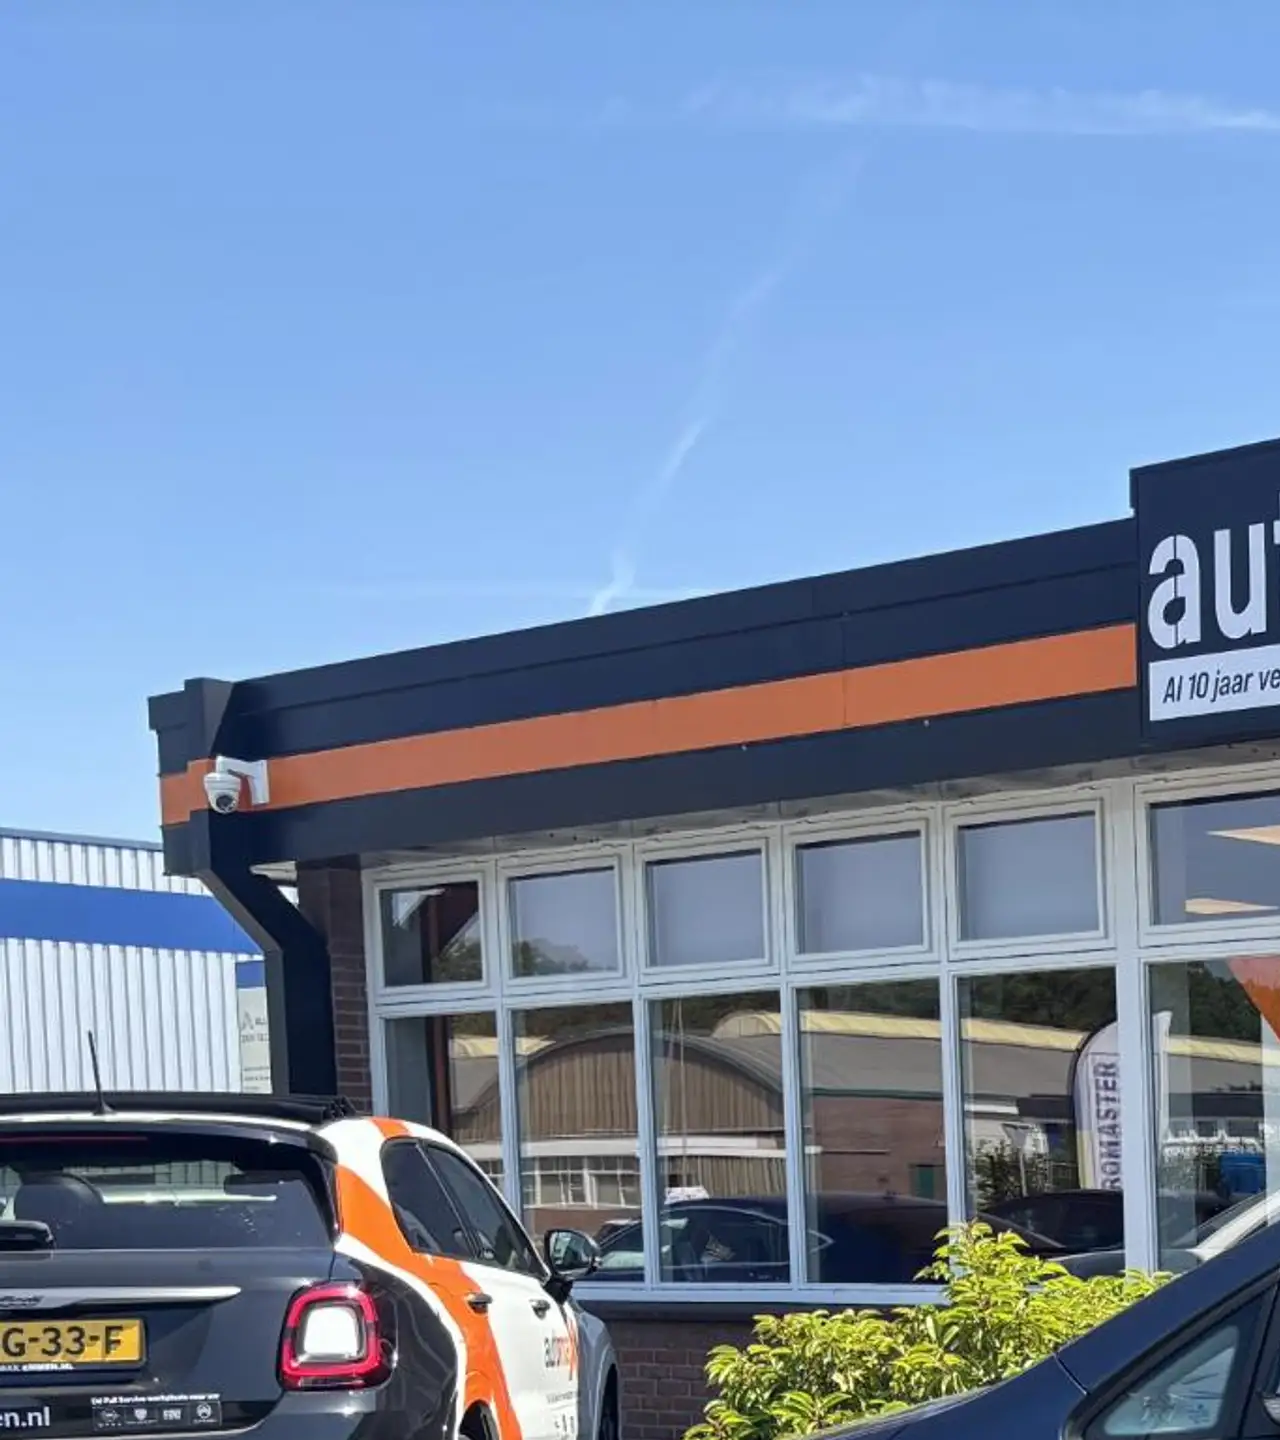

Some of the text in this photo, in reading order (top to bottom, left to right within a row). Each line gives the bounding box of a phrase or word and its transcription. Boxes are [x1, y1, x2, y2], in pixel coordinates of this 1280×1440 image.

[1163, 674, 1183, 703] Al
[1189, 671, 1210, 700] 10
[1211, 668, 1254, 702] jaar
[2, 1325, 124, 1358] G-33-F
[0, 1406, 51, 1429] n.nl
